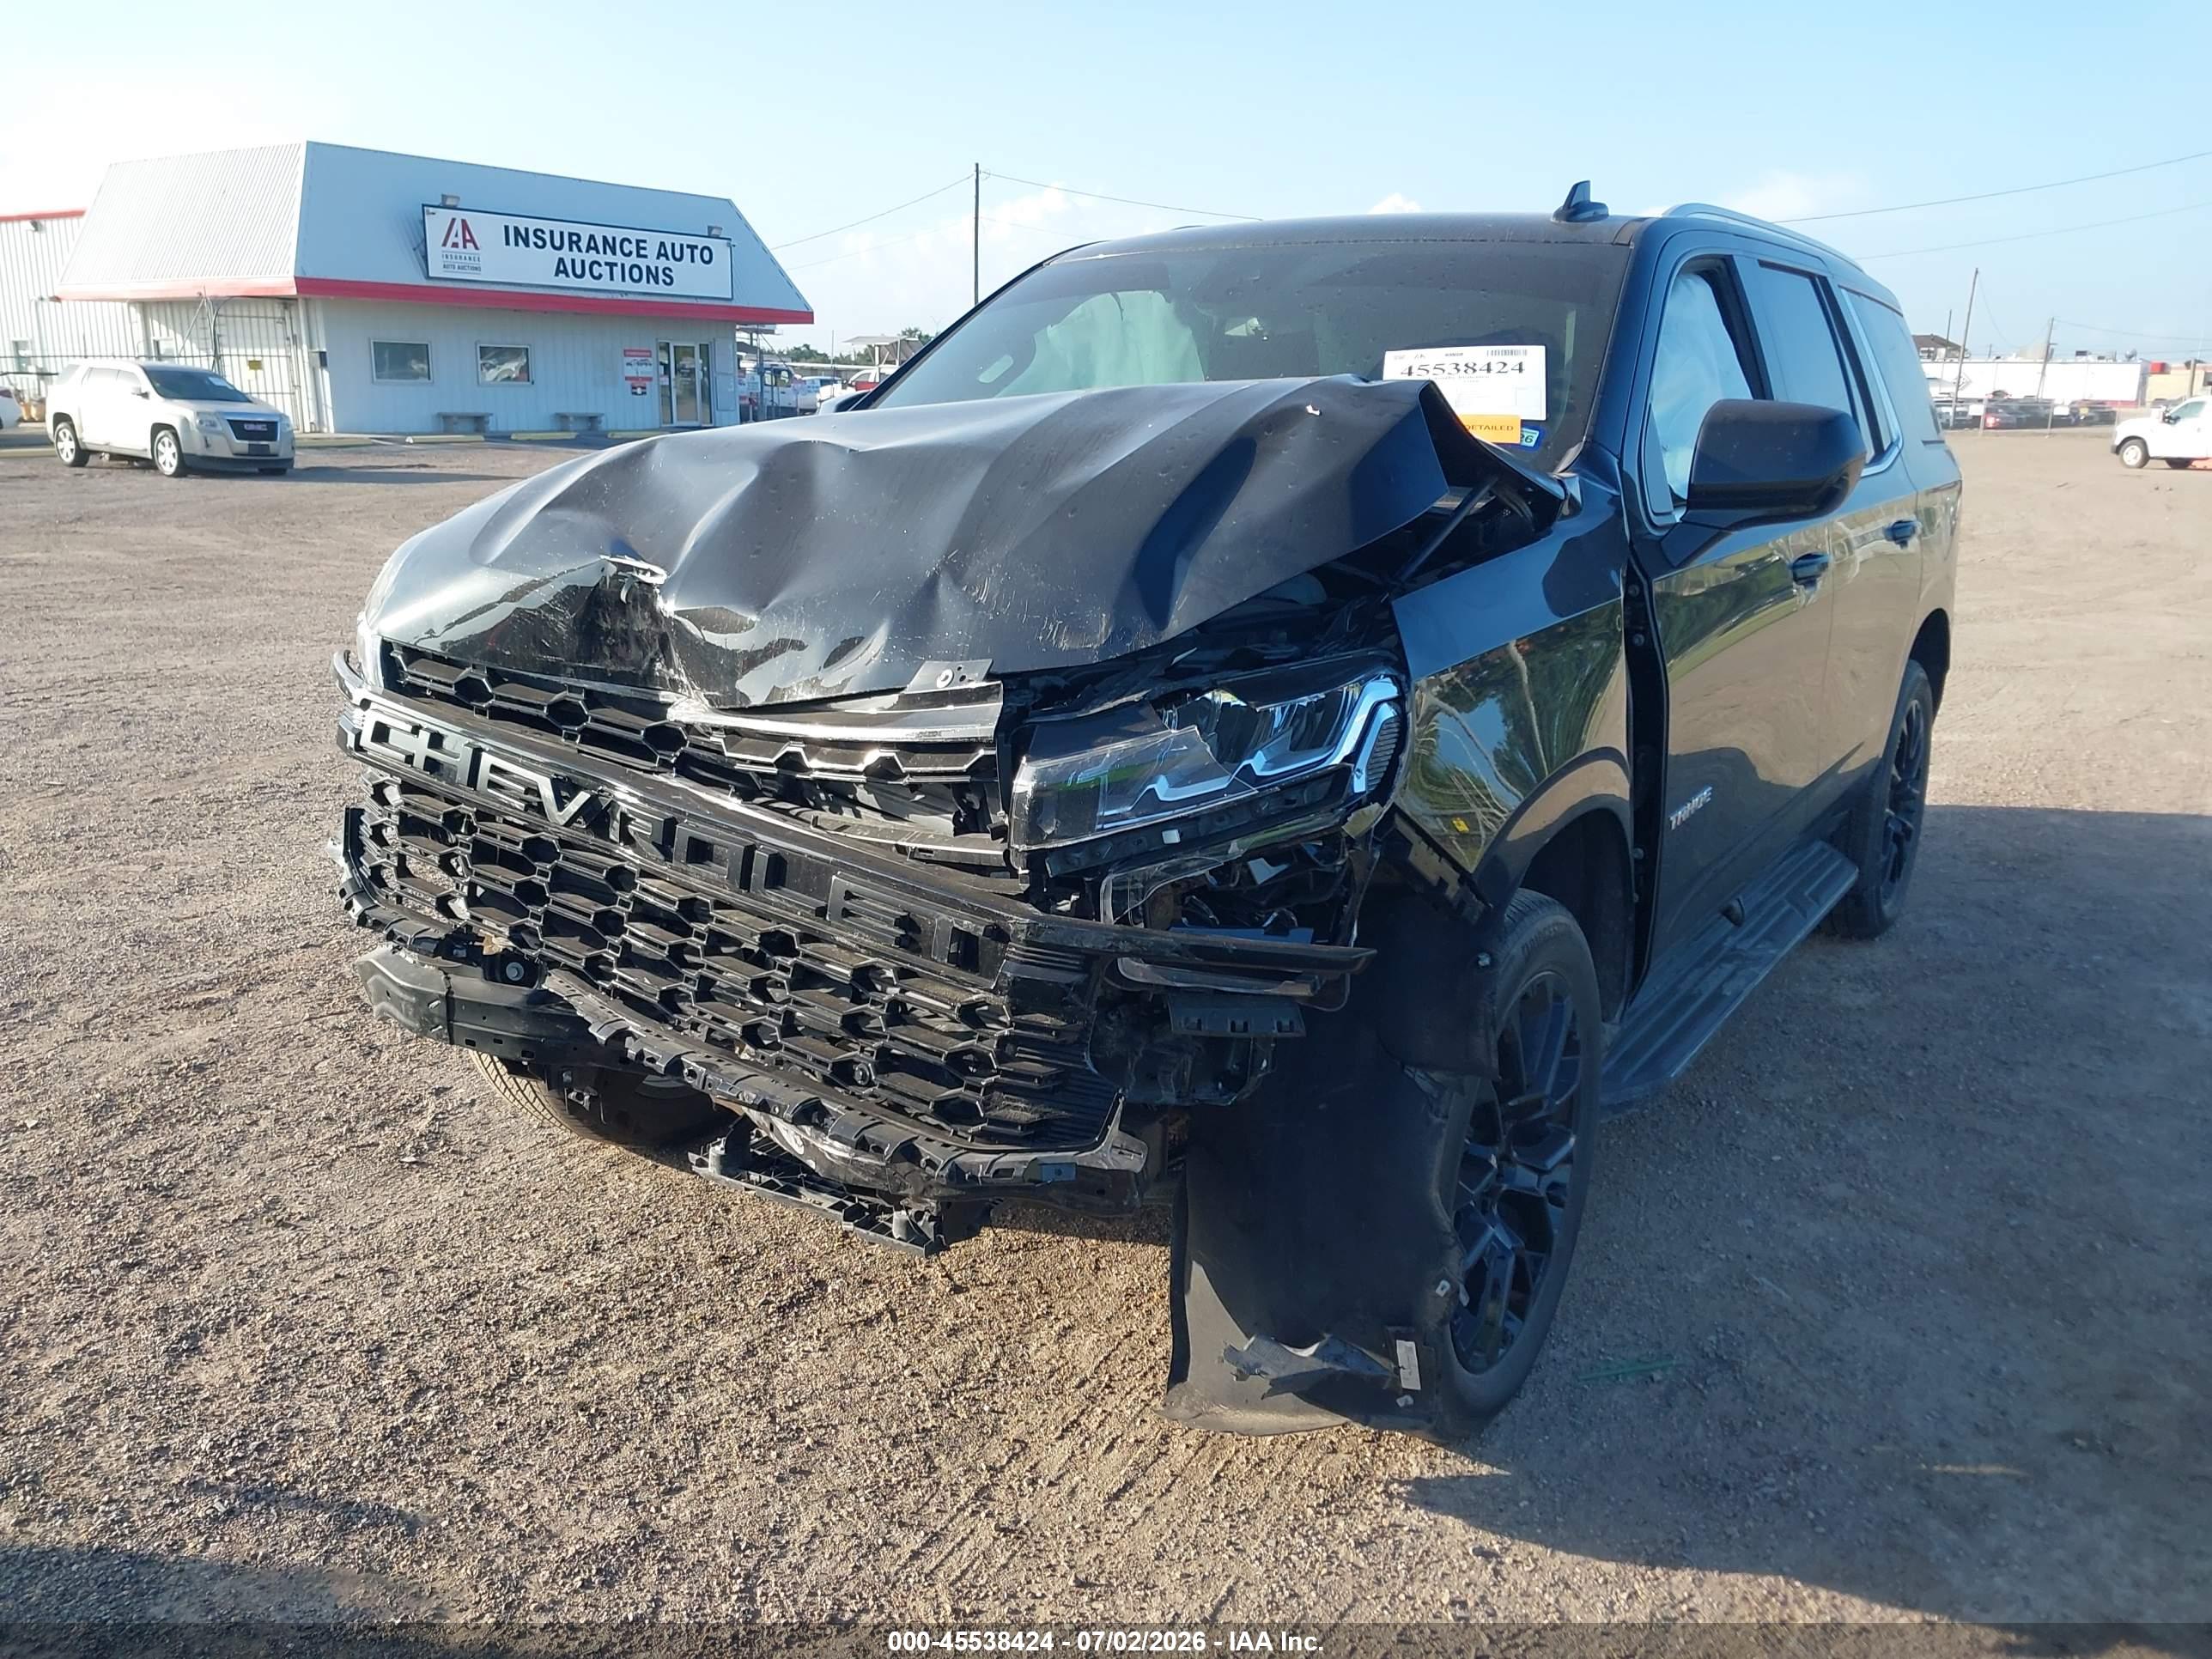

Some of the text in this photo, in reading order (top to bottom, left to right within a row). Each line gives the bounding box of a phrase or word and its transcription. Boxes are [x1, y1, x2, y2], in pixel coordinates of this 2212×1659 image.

[441, 253, 481, 262] INSURANCE
[503, 224, 714, 264] INSURANCE AUTO
[554, 257, 674, 286] AUCTIONS
[1401, 362, 1525, 376] 45538424
[358, 709, 988, 965] CHEVROLET
